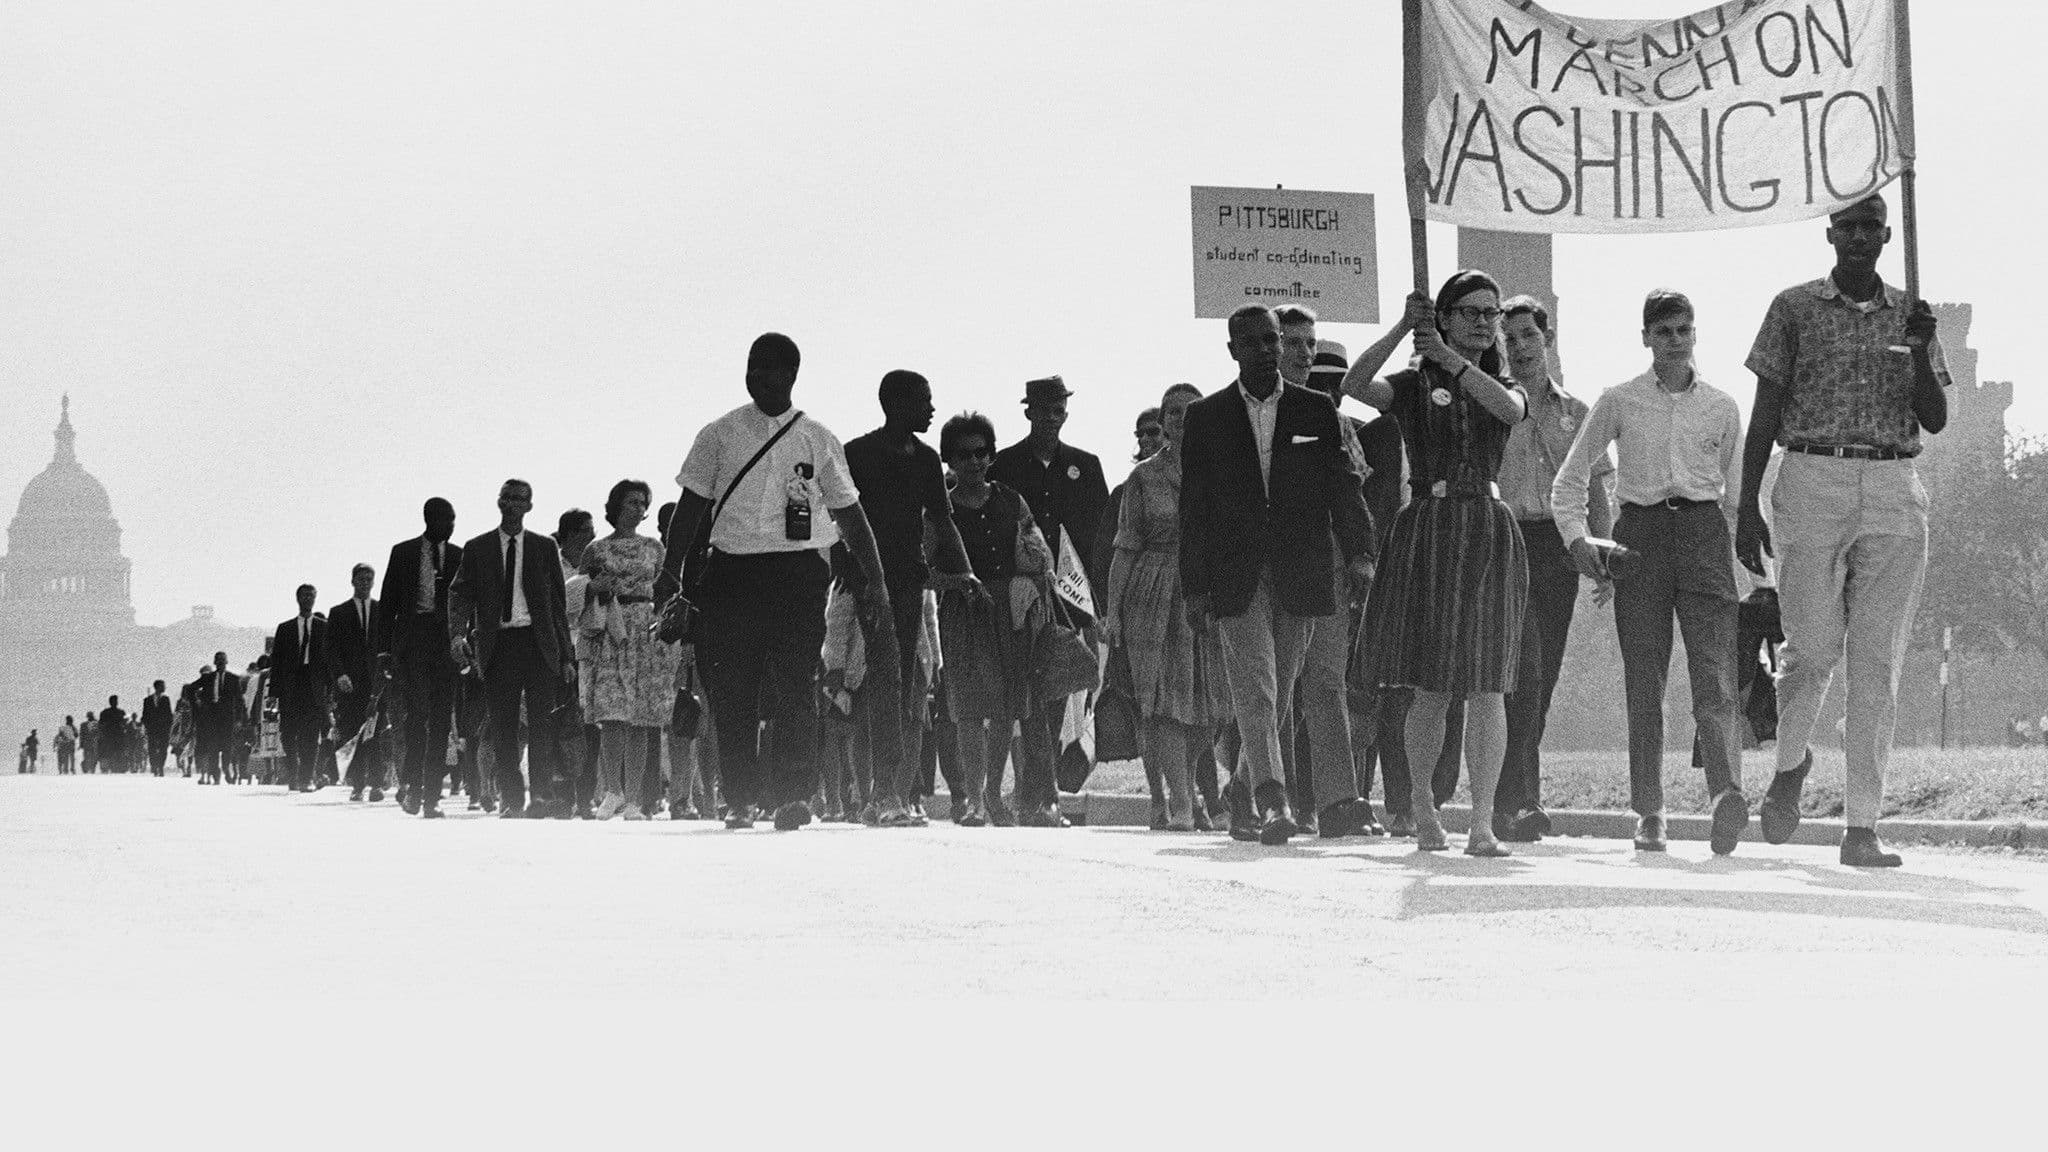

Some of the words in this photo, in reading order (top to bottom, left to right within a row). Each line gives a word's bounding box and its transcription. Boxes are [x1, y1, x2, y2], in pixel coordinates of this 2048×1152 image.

[1485, 17, 1741, 106] MARCH
[1756, 0, 1853, 77] ON
[1219, 205, 1338, 230] PITTSBURGH
[1206, 247, 1259, 262] student
[1244, 281, 1320, 298] committee
